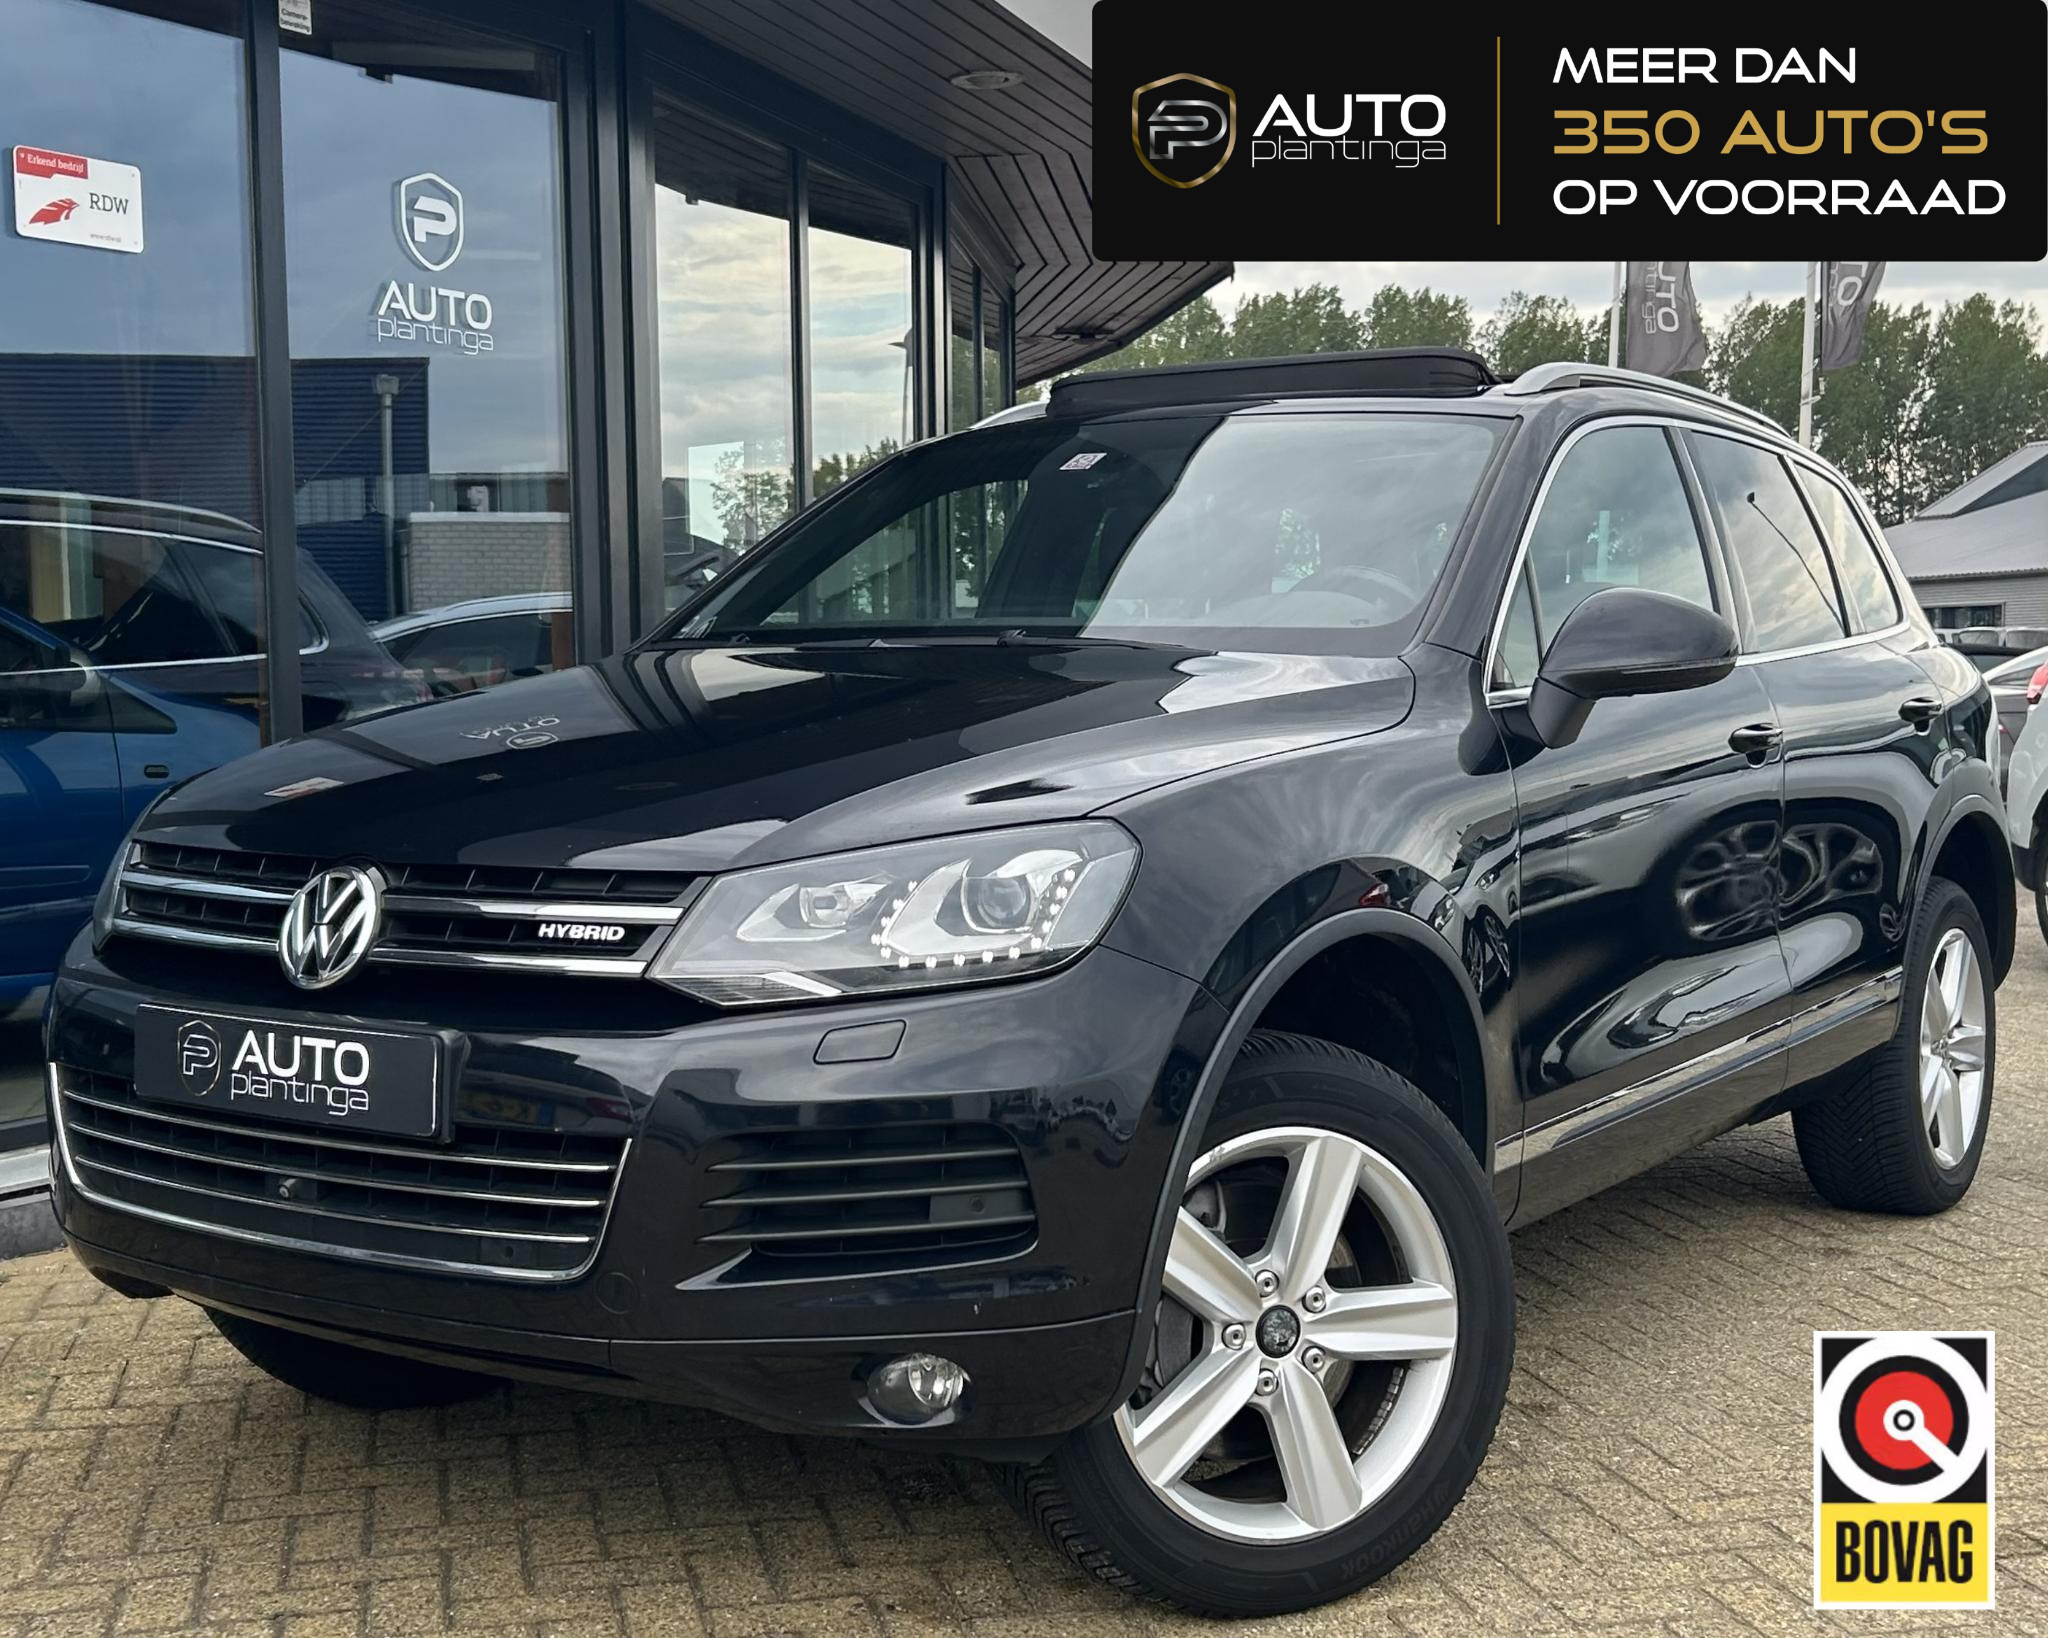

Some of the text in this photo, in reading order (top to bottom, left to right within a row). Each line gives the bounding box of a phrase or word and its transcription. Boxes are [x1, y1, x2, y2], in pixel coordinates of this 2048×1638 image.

[27, 154, 57, 168] Erkend
[89, 192, 129, 215] RDW
[377, 280, 493, 331] AUTO
[1656, 261, 1680, 333] UTO
[377, 316, 494, 356] plantinga
[537, 923, 626, 942] HYBRID
[231, 1029, 371, 1087] AUTO
[230, 1070, 370, 1117] plantinga
